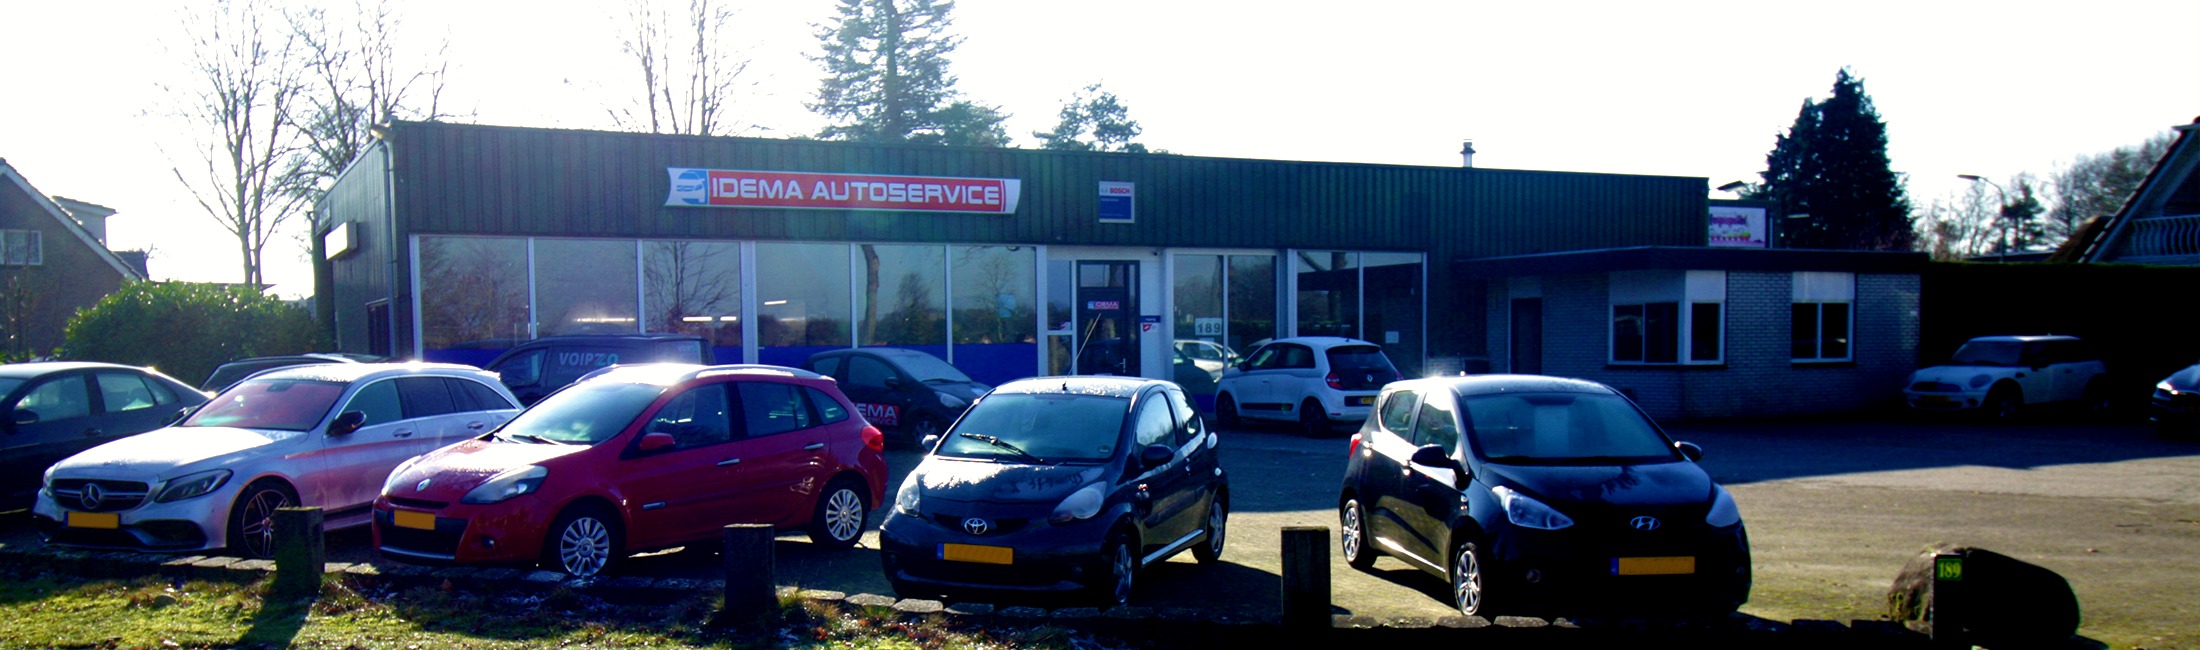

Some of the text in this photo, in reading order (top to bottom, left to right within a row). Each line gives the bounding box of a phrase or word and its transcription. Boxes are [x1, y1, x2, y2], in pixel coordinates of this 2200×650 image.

[712, 177, 1000, 205] IDEMA AUTOSERVICE
[1197, 322, 1221, 333] 189
[559, 352, 619, 367] VOIPZO
[855, 403, 897, 419] EMA
[1939, 562, 1962, 578] 189
